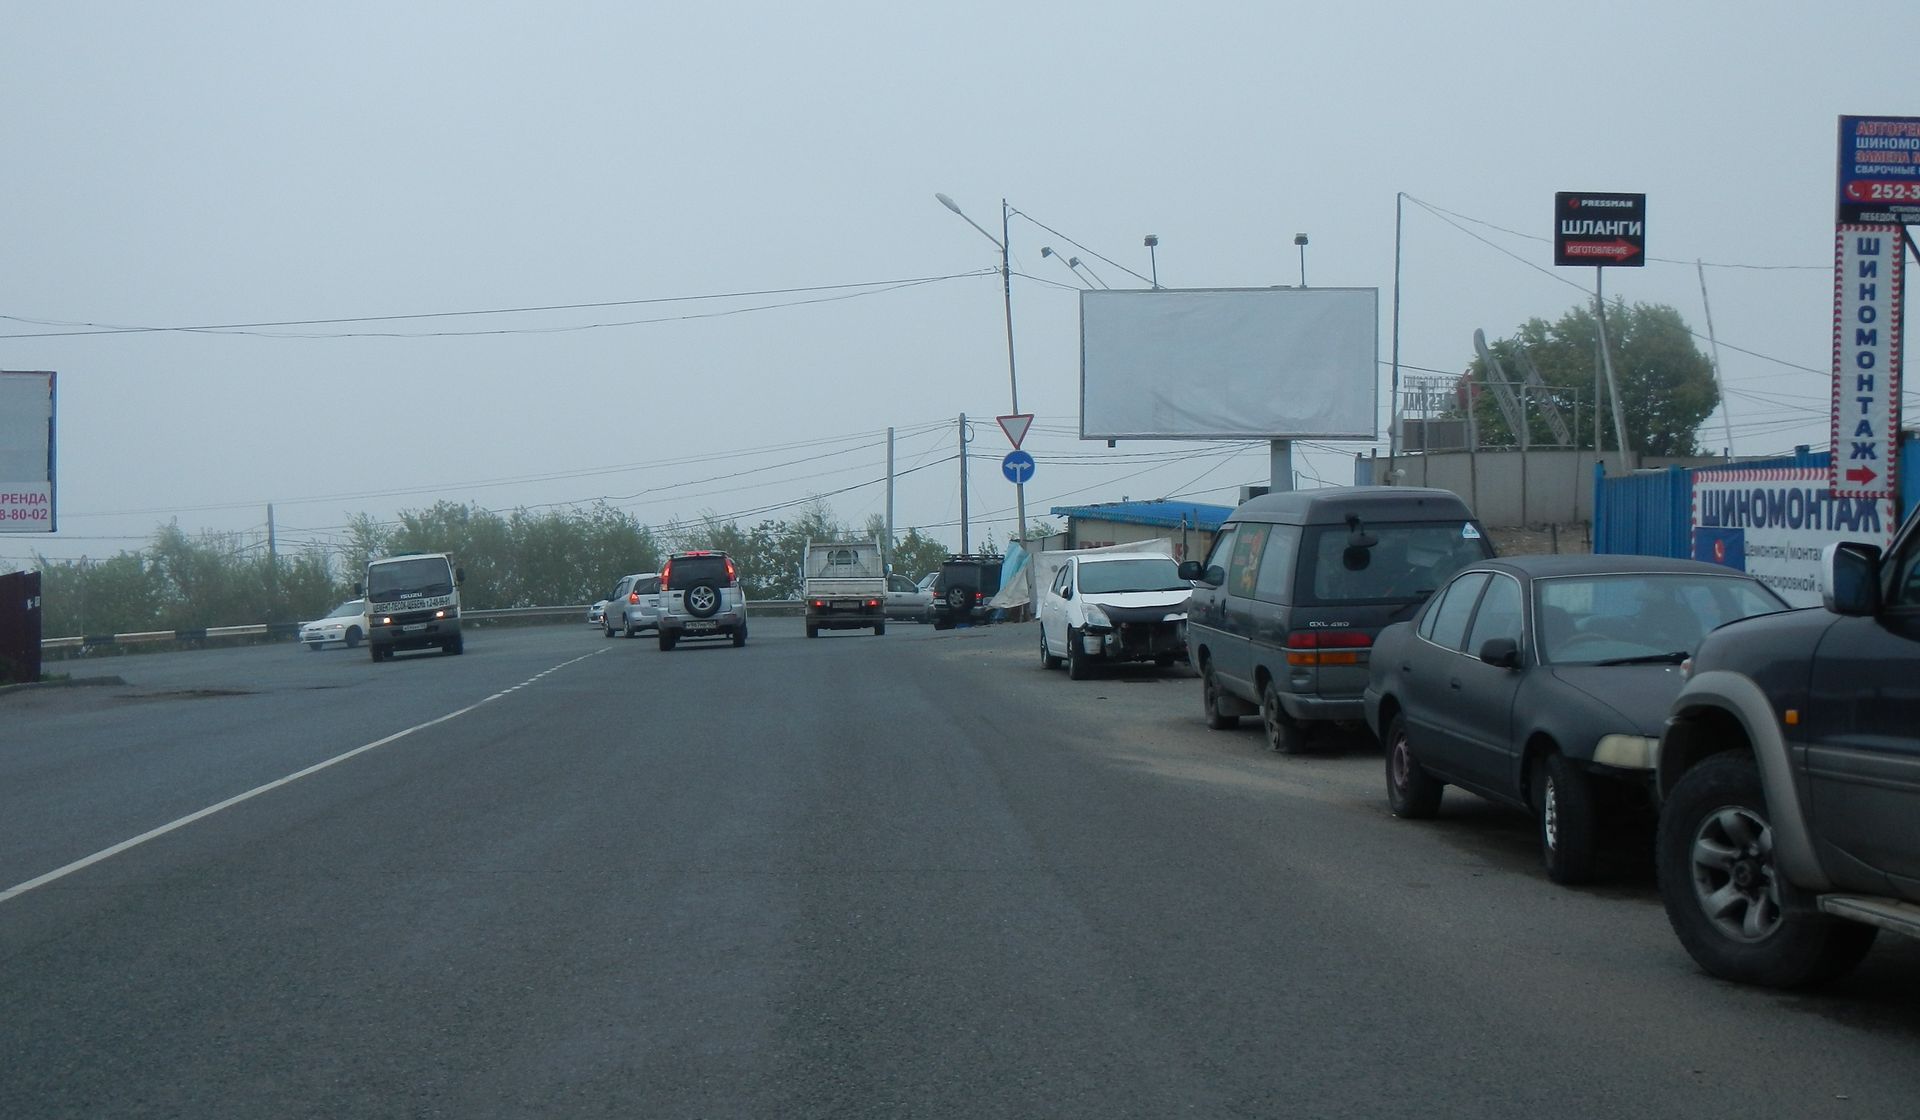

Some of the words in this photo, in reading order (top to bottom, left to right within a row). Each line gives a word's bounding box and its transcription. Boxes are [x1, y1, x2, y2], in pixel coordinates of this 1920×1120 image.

[1856, 121, 1920, 136] АВТОРЕ
[1855, 165, 1916, 174] СВАРОЧНЫЕ
[1871, 184, 1920, 199] 252-3
[1581, 199, 1633, 208] PRESSMAN
[1561, 220, 1641, 236] ШЛАНГИ
[1567, 245, 1628, 255] ИЗГОТОВЛЕНИЕ
[1849, 237, 1880, 460] ШИНОМОНТАЖ
[0, 493, 47, 506] РЕНДА
[1702, 487, 1880, 533] ШИНОМОНТАЖ
